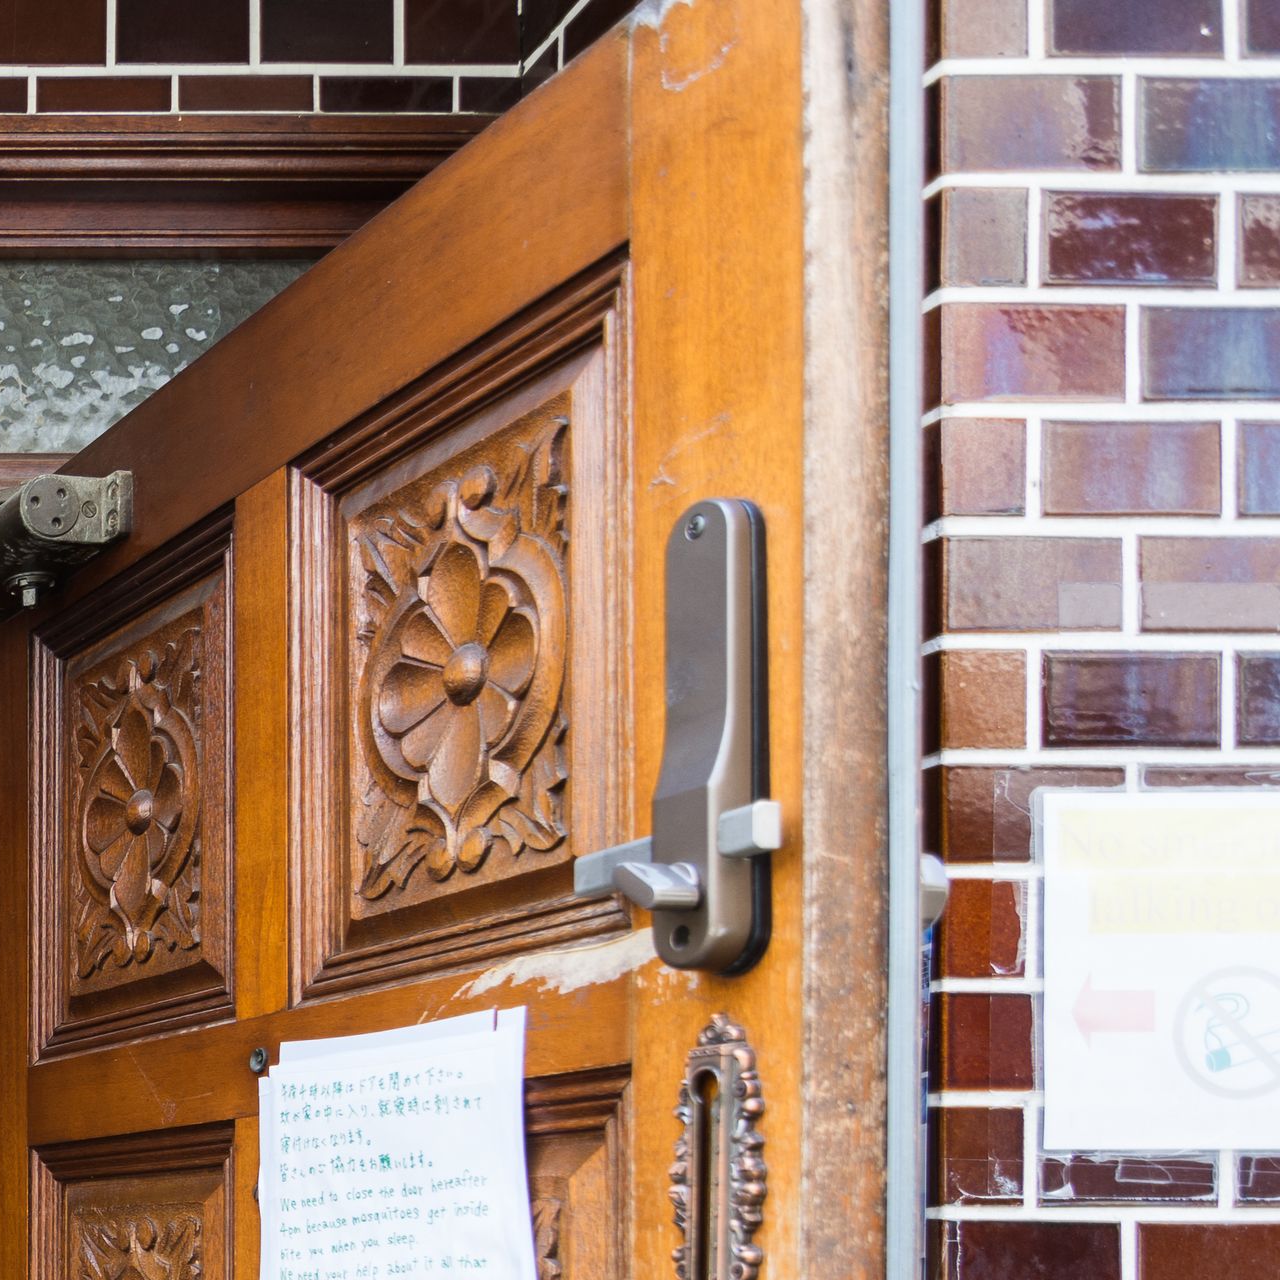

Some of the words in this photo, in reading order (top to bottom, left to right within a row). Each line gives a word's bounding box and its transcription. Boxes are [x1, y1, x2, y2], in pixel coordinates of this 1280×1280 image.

[280, 1198, 297, 1212] We
[301, 1191, 324, 1208] need
[328, 1191, 338, 1203] to
[345, 1187, 373, 1201] close
[378, 1186, 395, 1199] the
[401, 1183, 424, 1198] door
[306, 1217, 348, 1235] because
[352, 1206, 420, 1225] mosquitoes
[427, 1207, 448, 1225] get
[309, 1247, 324, 1257] you
[331, 1240, 356, 1254] when
[361, 1238, 380, 1253] you
[356, 1264, 379, 1280] help
[387, 1257, 418, 1275] about
[457, 1254, 488, 1269] that
